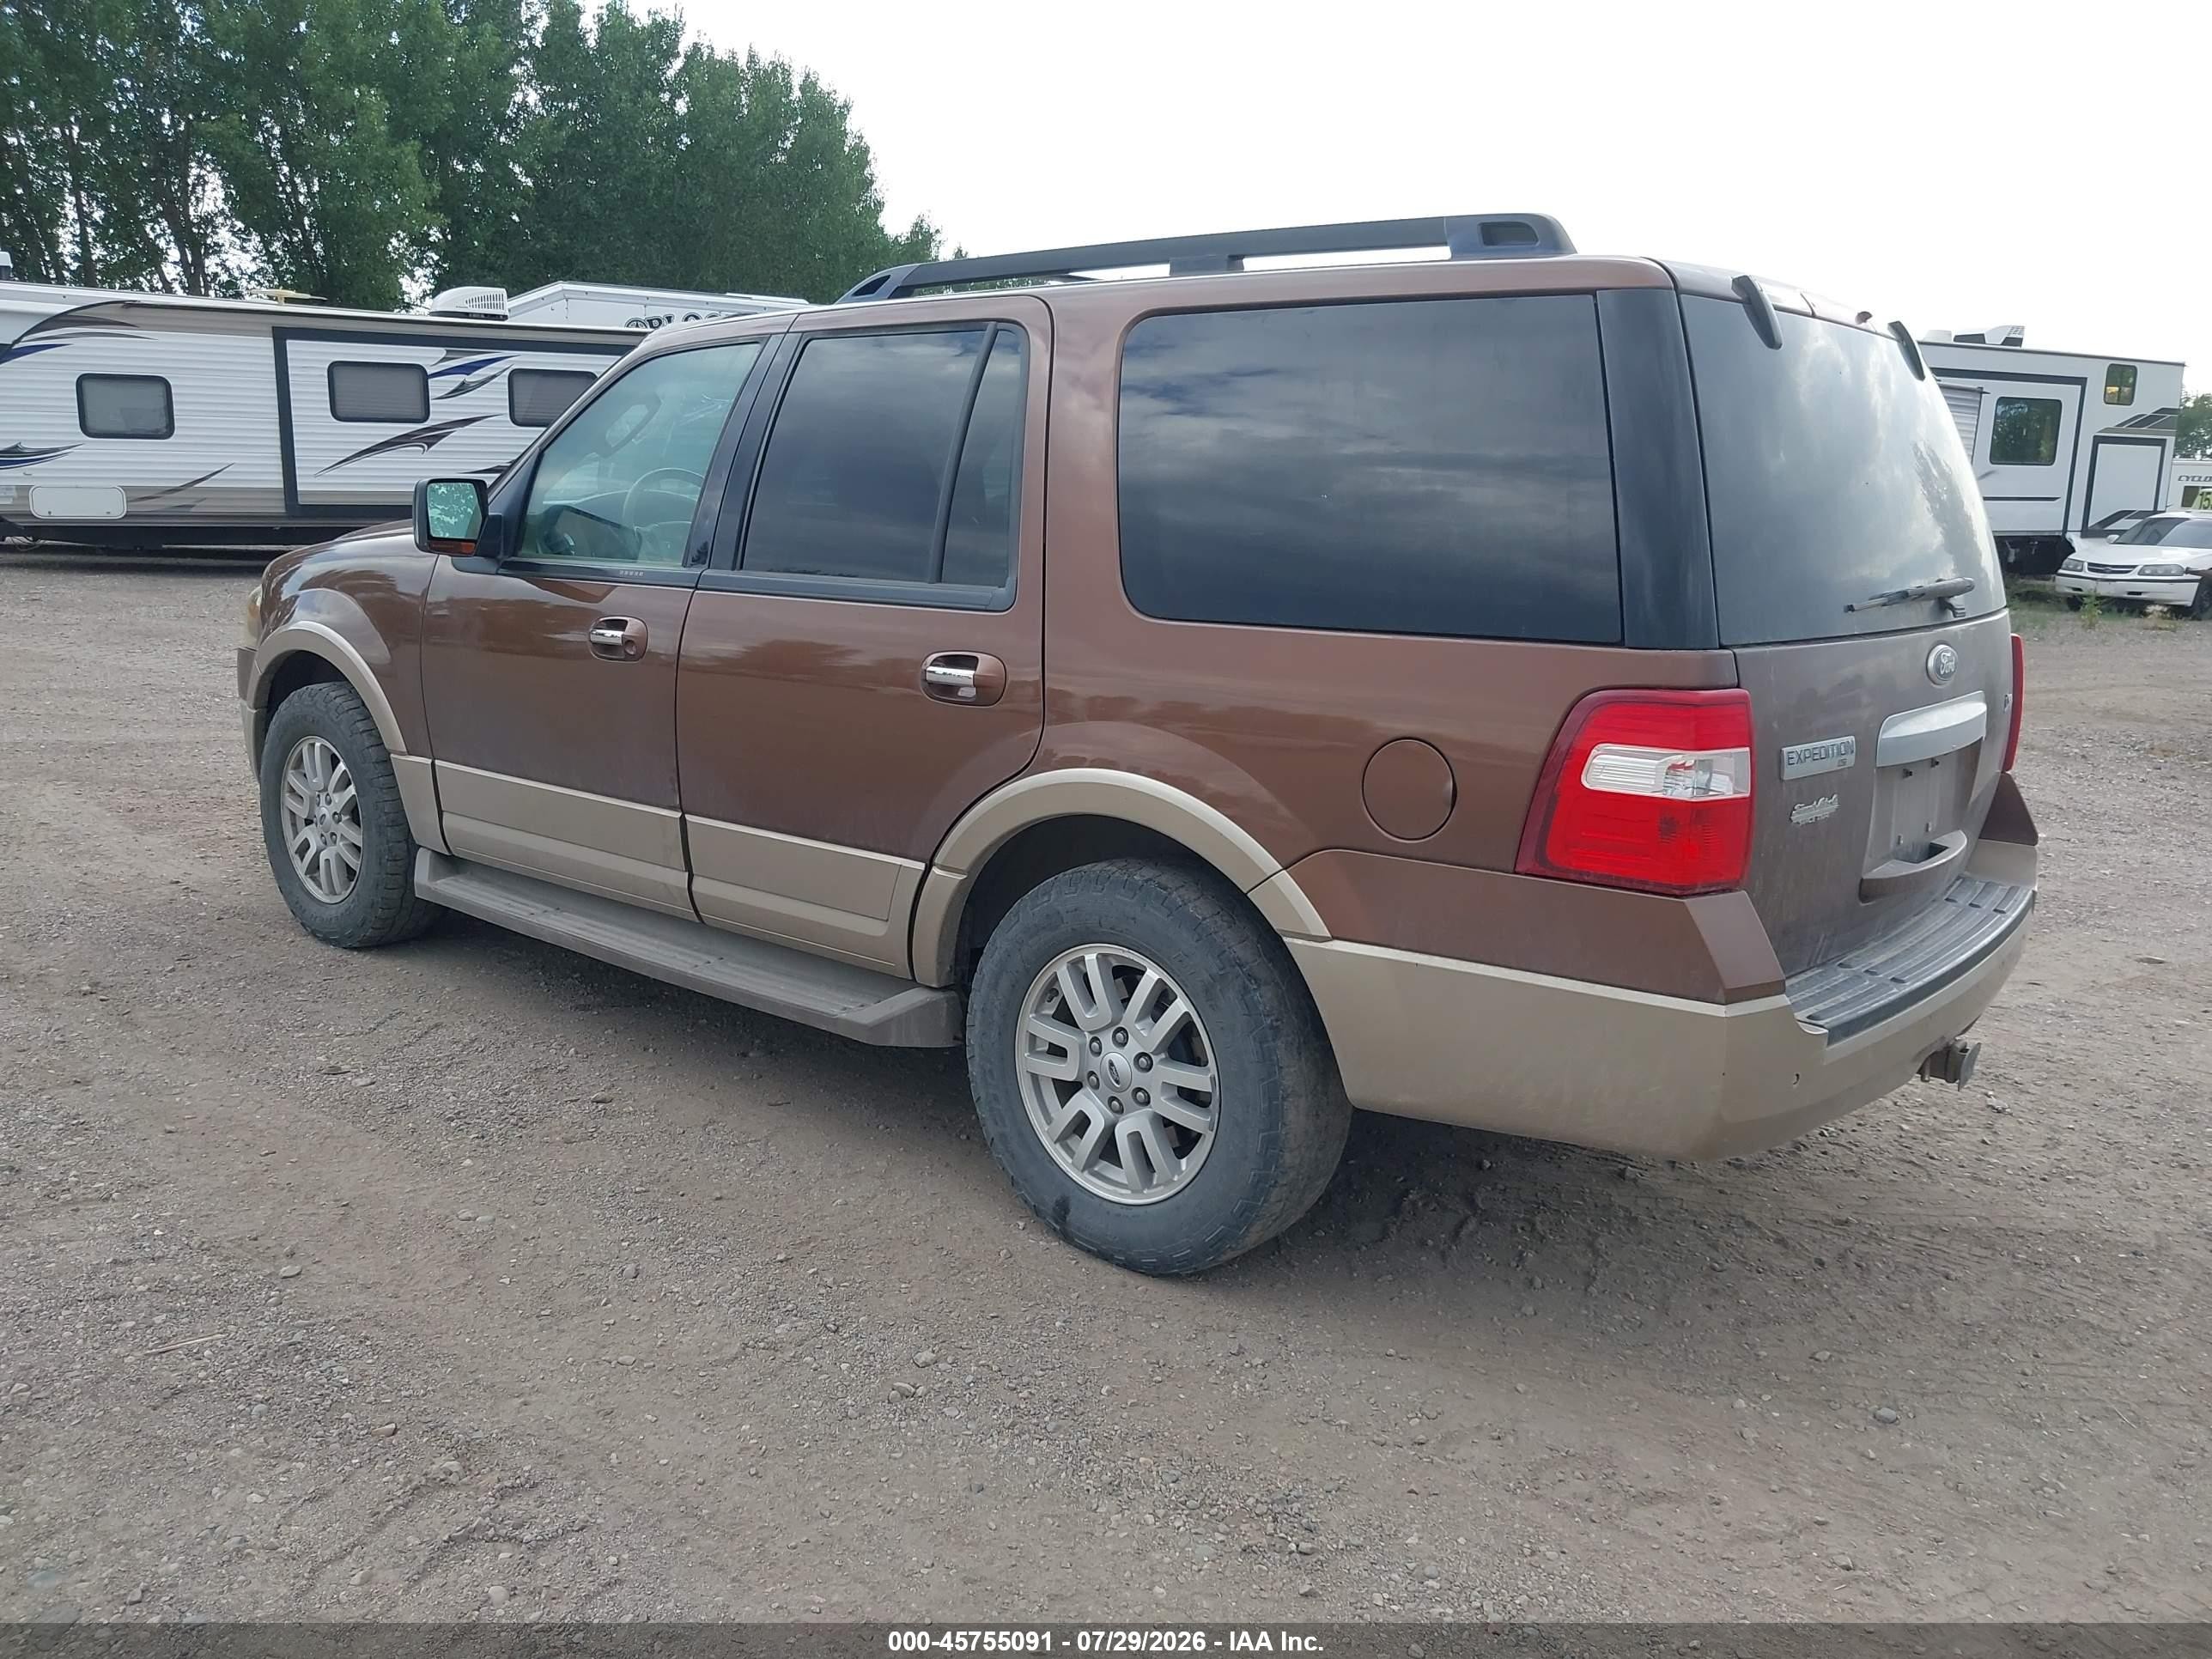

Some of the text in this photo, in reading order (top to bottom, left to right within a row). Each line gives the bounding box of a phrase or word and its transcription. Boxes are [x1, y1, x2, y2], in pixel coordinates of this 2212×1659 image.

[2198, 491, 2212, 510] 15
[1940, 651, 1956, 675] Ford
[1786, 739, 1855, 766] EXPEDITION
